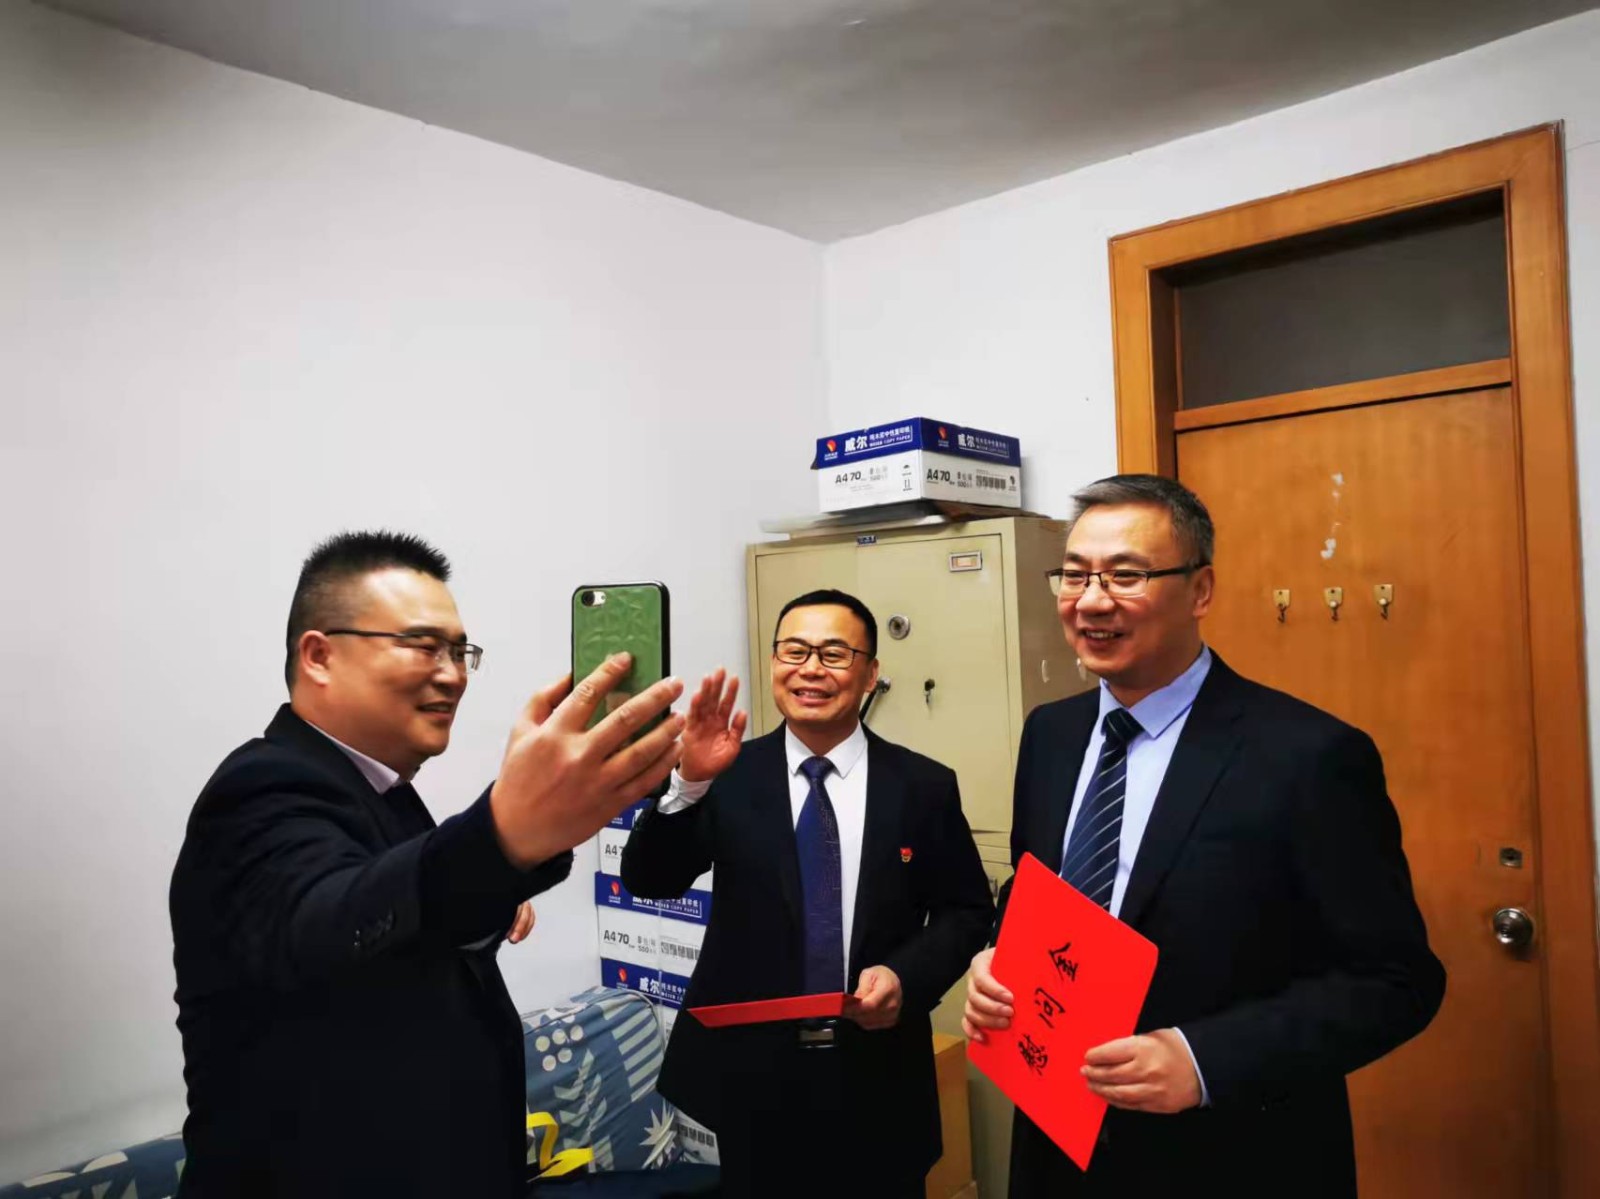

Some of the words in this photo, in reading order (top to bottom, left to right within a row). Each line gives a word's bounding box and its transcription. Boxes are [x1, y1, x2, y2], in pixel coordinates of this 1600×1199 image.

[845, 435, 868, 452] 威尔
[958, 433, 976, 448] 威尔
[835, 473, 848, 484] A4
[850, 471, 861, 481] 70
[927, 468, 938, 480] A4
[940, 471, 950, 482] 70
[605, 844, 618, 856] A4
[604, 930, 616, 942] A4
[617, 932, 629, 944] 70
[640, 977, 660, 994] 威尔
[1017, 942, 1080, 1077] 慰问金
